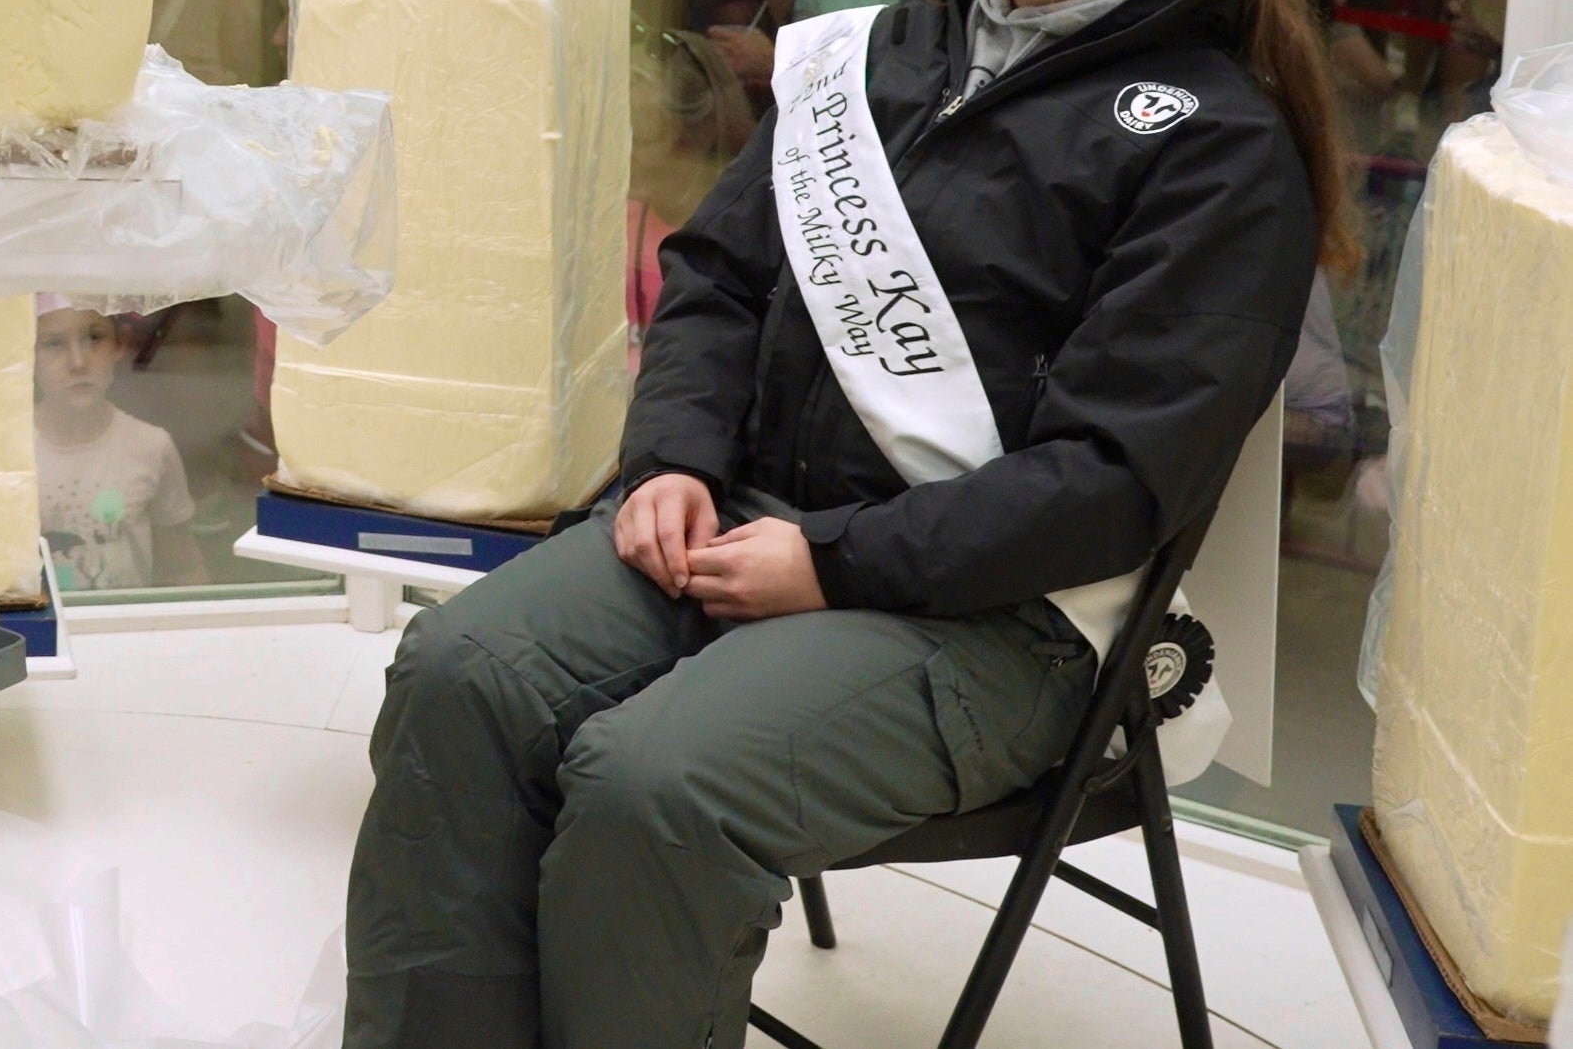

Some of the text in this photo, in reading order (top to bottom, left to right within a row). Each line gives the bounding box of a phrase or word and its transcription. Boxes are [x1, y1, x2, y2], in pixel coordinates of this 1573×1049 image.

[1119, 110, 1155, 130] DAIRY
[777, 147, 875, 357] of the Milky Way
[812, 91, 945, 377] Princess Kay
